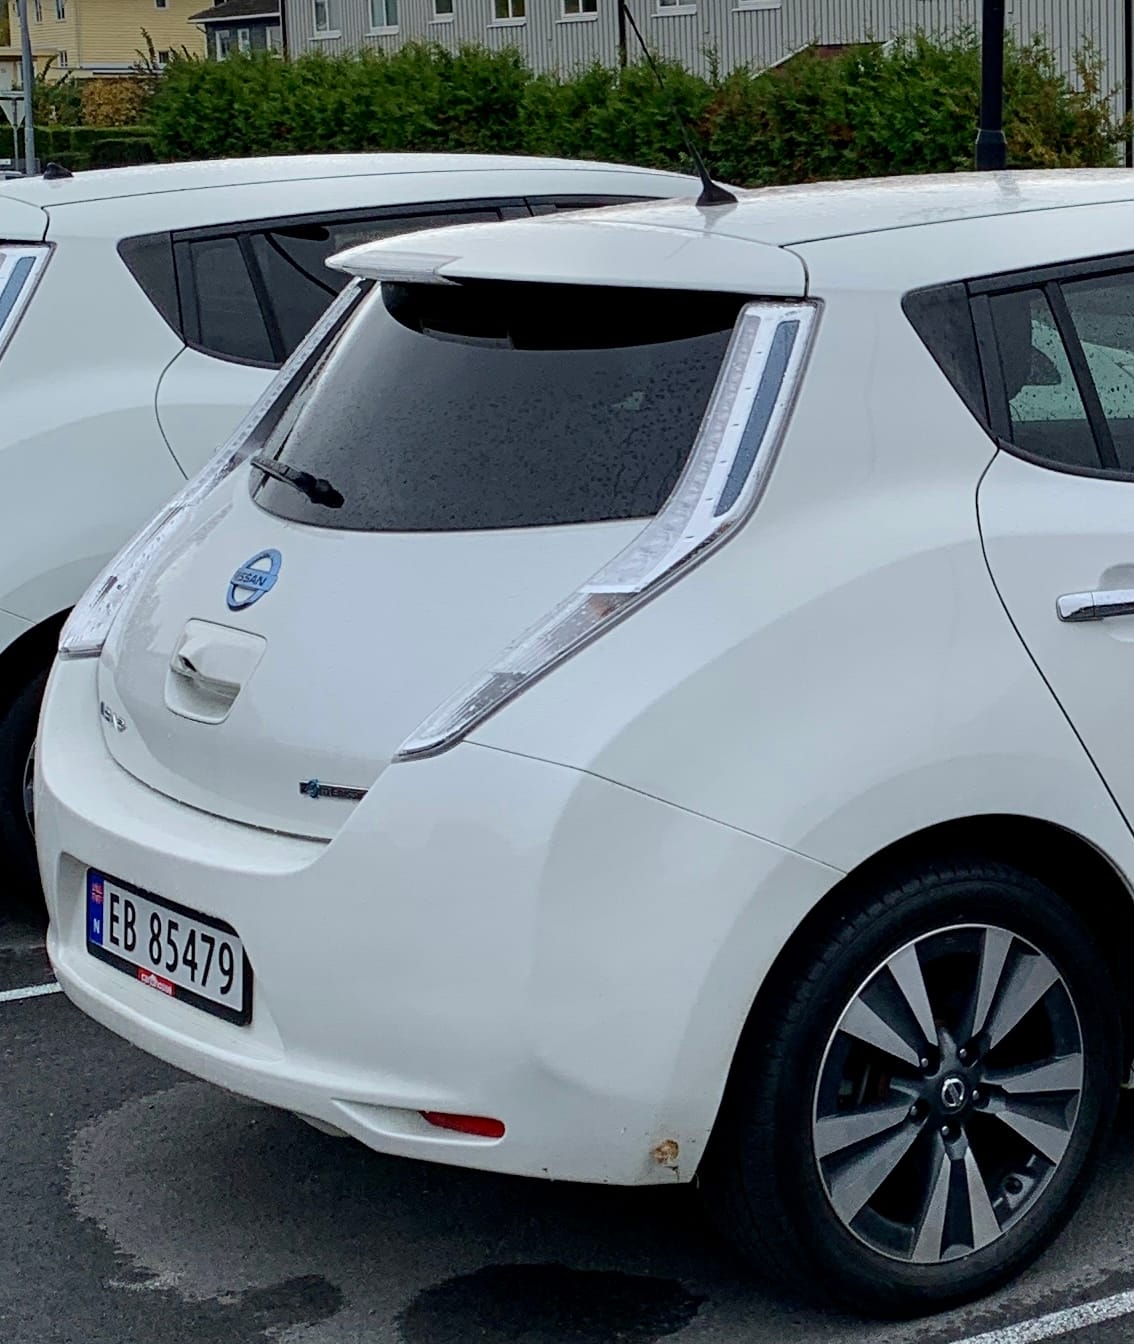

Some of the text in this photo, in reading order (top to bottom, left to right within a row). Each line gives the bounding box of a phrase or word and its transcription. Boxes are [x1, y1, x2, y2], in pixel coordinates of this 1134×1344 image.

[233, 571, 267, 586] SSAN
[92, 917, 100, 934] N
[109, 892, 234, 995] EB 85479
